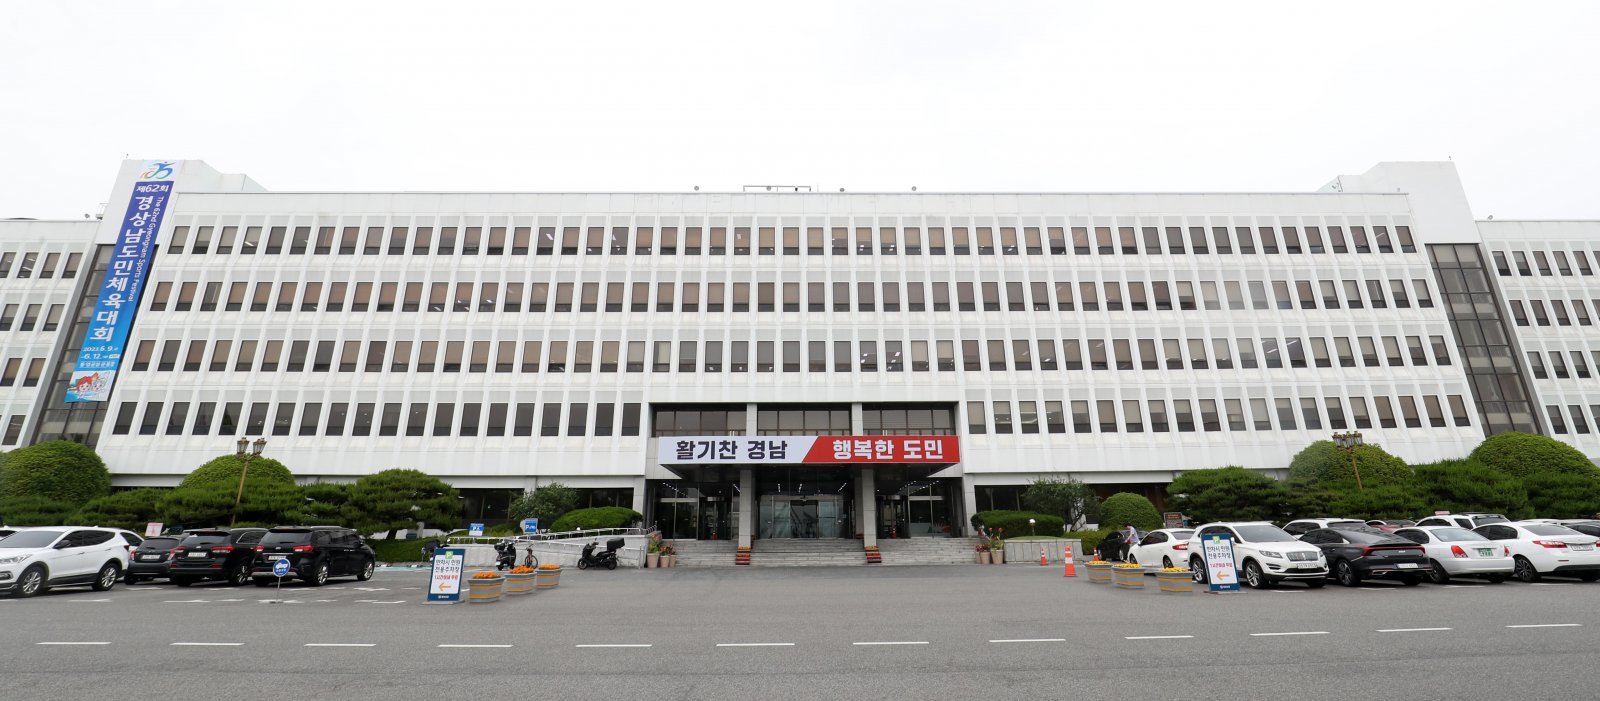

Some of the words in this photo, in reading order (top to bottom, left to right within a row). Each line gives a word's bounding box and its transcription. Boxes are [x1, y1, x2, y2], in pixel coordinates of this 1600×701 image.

[156, 197, 164, 207] The
[150, 208, 160, 222] 62nd
[90, 196, 153, 341] 경상남도민체육대회
[134, 259, 146, 278] Sports
[676, 440, 738, 460] 활기찬
[747, 440, 788, 460] 경남
[833, 439, 894, 460] 행복한
[903, 439, 944, 460] 도민
